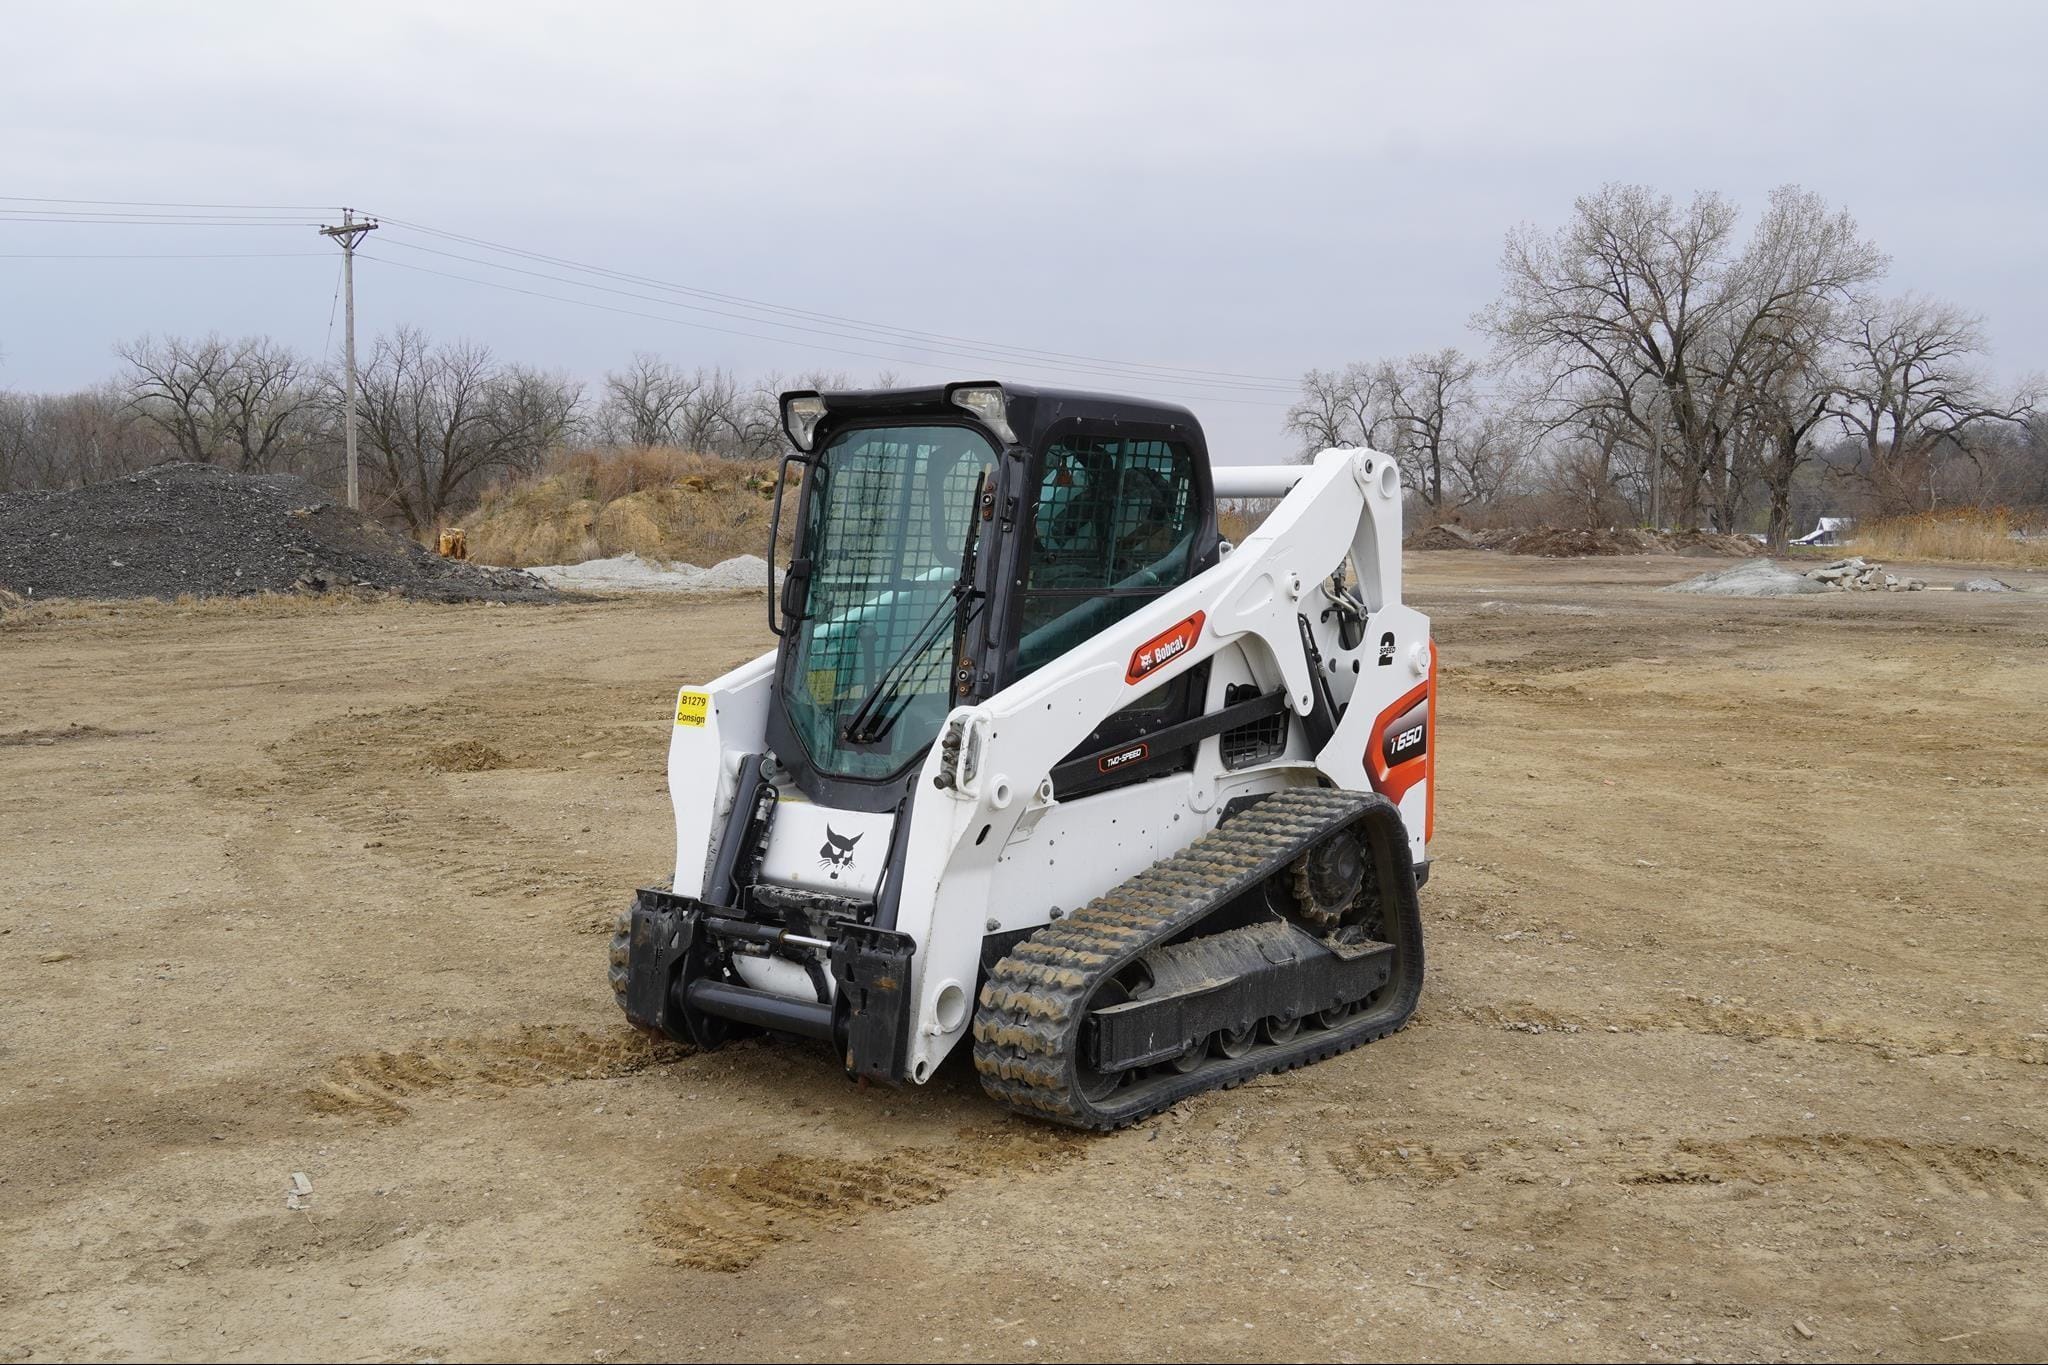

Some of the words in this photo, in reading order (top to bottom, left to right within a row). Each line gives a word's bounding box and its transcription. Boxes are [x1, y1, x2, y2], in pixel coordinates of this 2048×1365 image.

[1154, 635, 1184, 663] Bobcat
[1378, 631, 1395, 666] 2
[682, 696, 706, 706] B1279
[678, 712, 705, 725] Consign
[1391, 725, 1423, 754] T650
[1107, 748, 1141, 768] TWO-SPEED
